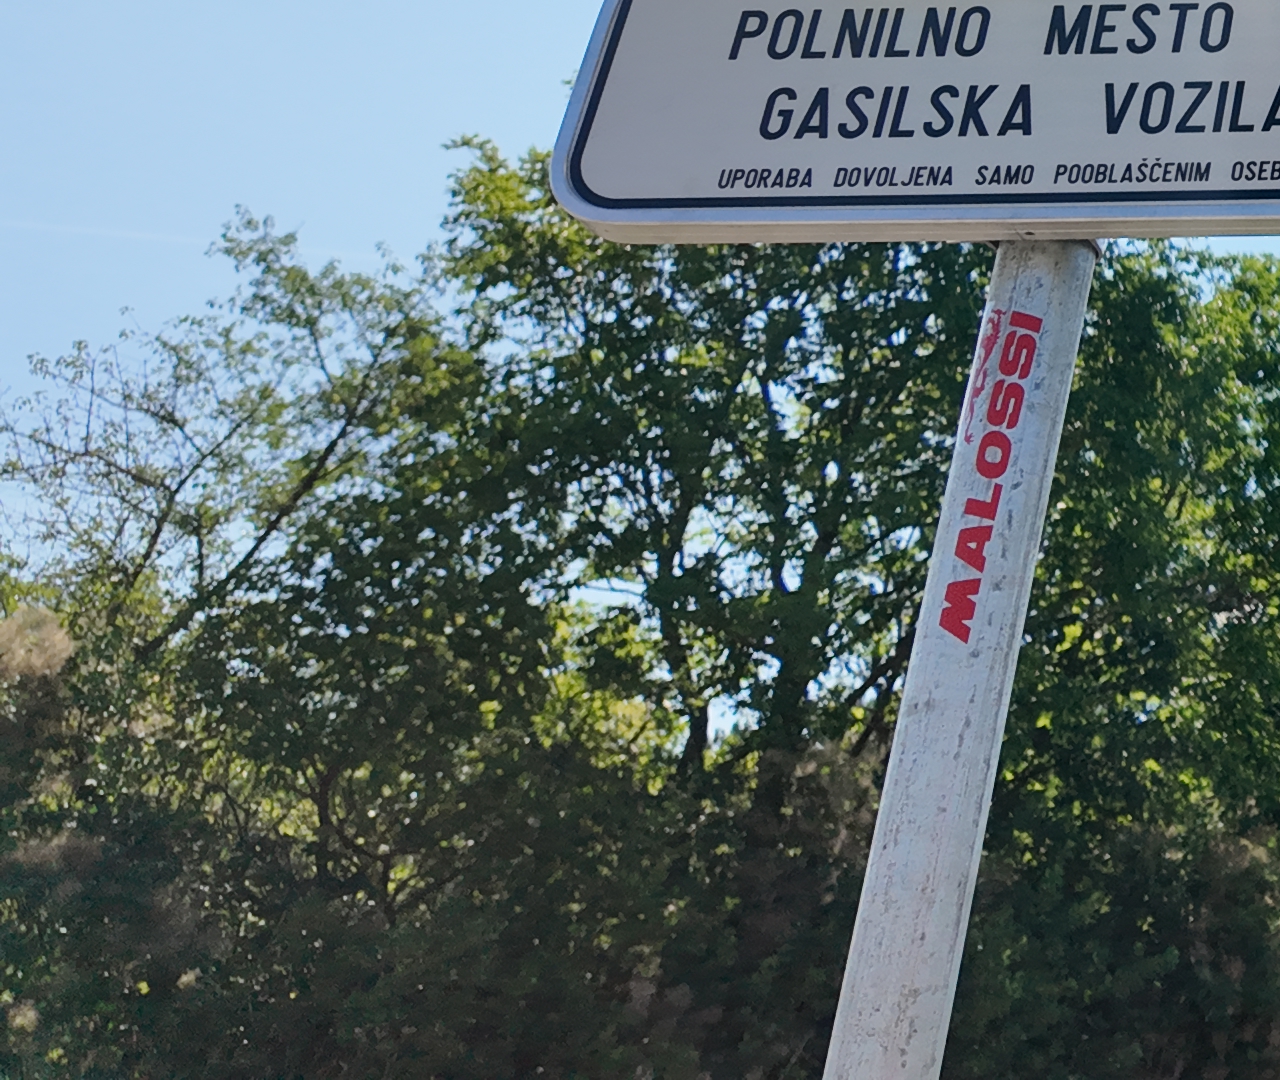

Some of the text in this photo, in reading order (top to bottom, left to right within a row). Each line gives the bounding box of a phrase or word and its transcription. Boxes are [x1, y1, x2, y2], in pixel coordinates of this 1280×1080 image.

[728, 6, 991, 60] POLNILNO
[1043, 2, 1234, 55] MESTO
[759, 84, 1032, 140] GASILSKA
[718, 168, 812, 189] UPORABA
[833, 166, 952, 187] DOVOLJENA
[975, 165, 1034, 185] SAMO
[1054, 158, 1211, 184] POOBLAŠČENIM
[938, 310, 1044, 644] MALOSSI
